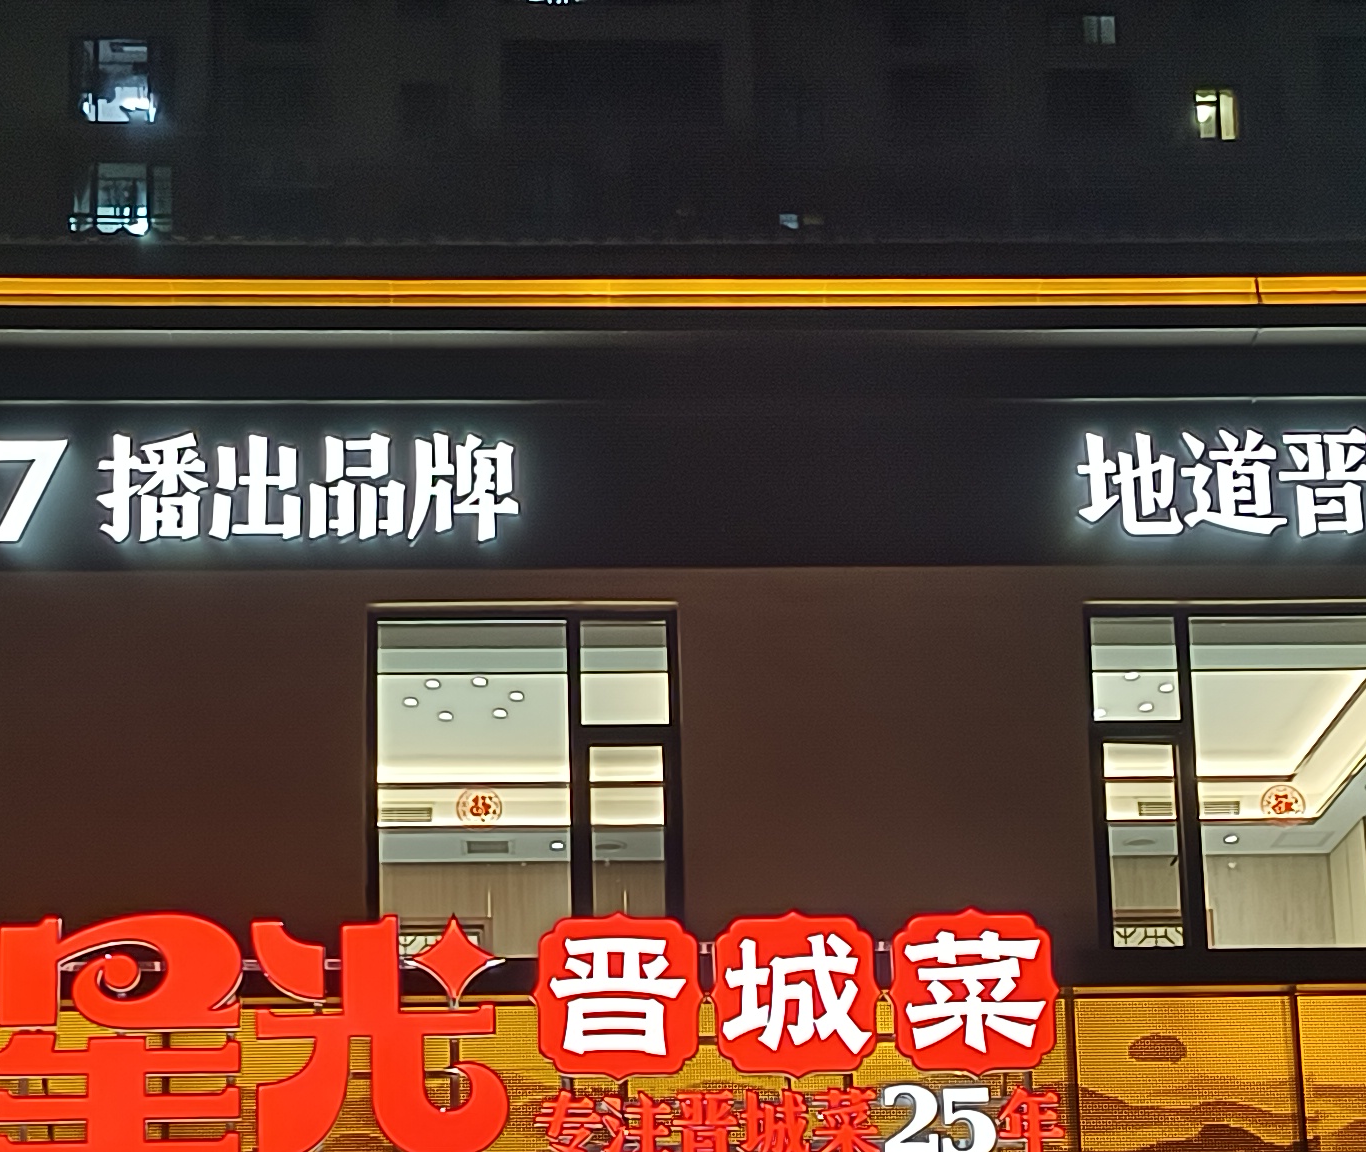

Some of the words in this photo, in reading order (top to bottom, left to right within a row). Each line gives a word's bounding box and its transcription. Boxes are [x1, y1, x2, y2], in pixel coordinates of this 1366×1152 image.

[97, 431, 520, 545] 播出品牌
[549, 932, 1047, 1058] 晋城菜
